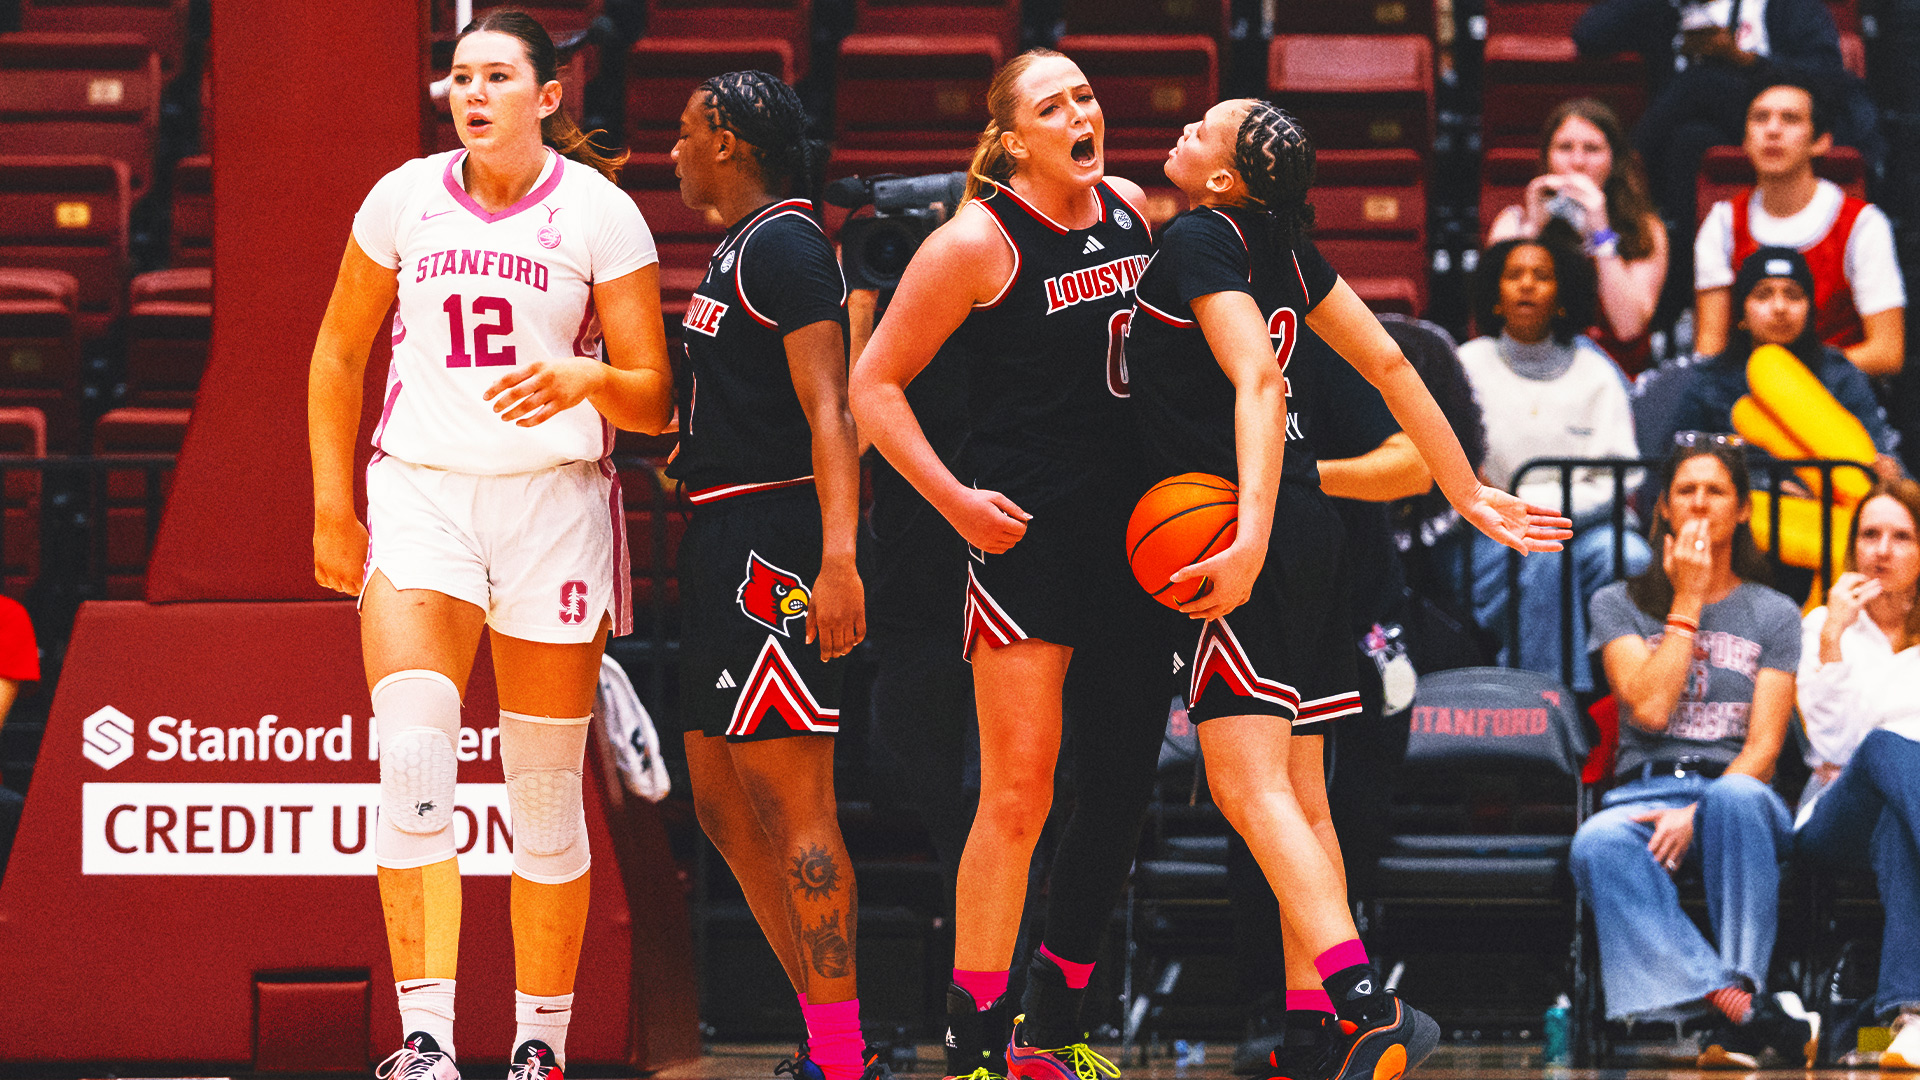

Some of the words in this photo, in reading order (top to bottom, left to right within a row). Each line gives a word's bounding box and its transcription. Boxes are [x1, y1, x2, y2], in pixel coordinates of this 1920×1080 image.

[416, 249, 549, 292] STANFORD
[443, 293, 517, 369] 12
[147, 714, 352, 762] Stanford
[104, 803, 314, 854] CREDIT
[332, 804, 514, 855] UON
